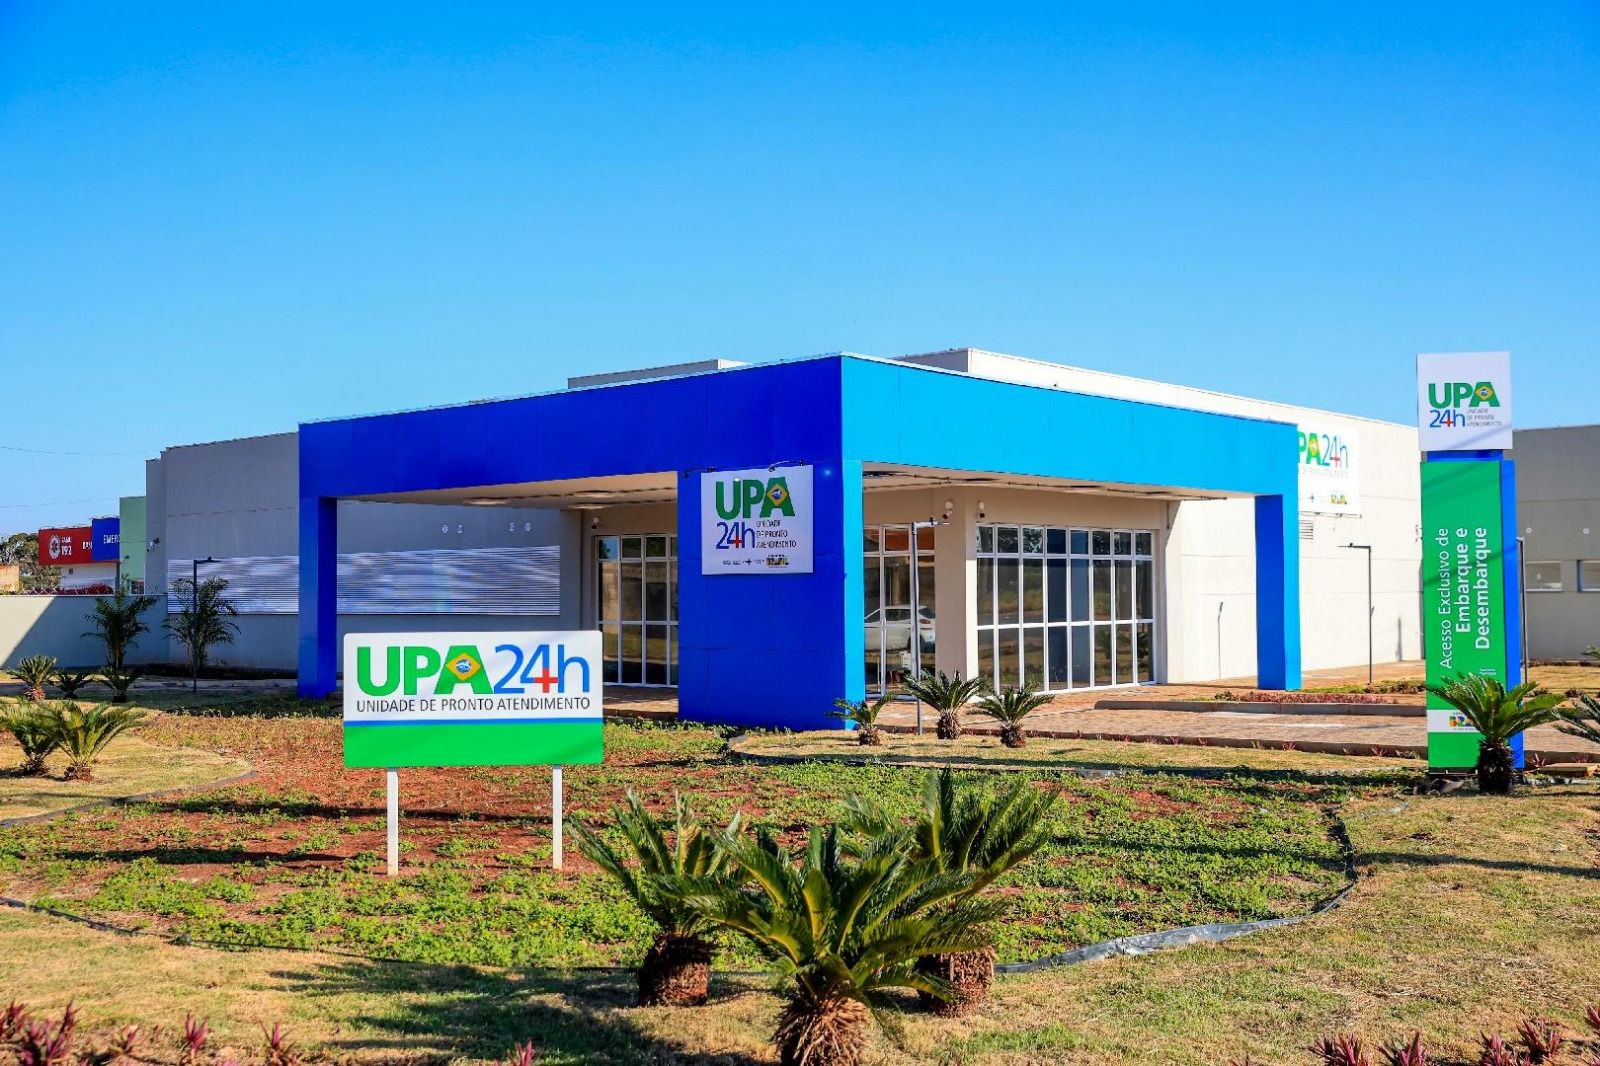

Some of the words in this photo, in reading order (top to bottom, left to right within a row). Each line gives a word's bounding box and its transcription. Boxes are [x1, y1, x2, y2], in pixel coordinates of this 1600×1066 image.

[1428, 382, 1500, 409] UPA
[1429, 409, 1465, 428] 24h
[1298, 431, 1321, 465] PA
[1321, 434, 1348, 468] 24h
[716, 477, 796, 520] UPA
[716, 522, 755, 549] 24h
[756, 540, 797, 549] ATENDIMENTO
[765, 530, 788, 538] PRONTO
[1435, 528, 1449, 546] de
[1456, 527, 1468, 538] e
[61, 545, 72, 555] 192
[1437, 551, 1451, 614] Exclusivo
[1454, 543, 1472, 633] Embarque
[1473, 527, 1491, 649] Desembarque
[1440, 620, 1452, 669] Acesso
[357, 645, 494, 697] UPA
[493, 644, 591, 694] 24h
[357, 700, 415, 713] UNIDADE
[420, 699, 436, 711] DE
[441, 698, 493, 711] PRONTO
[497, 697, 590, 710] ATENDIMENTO
